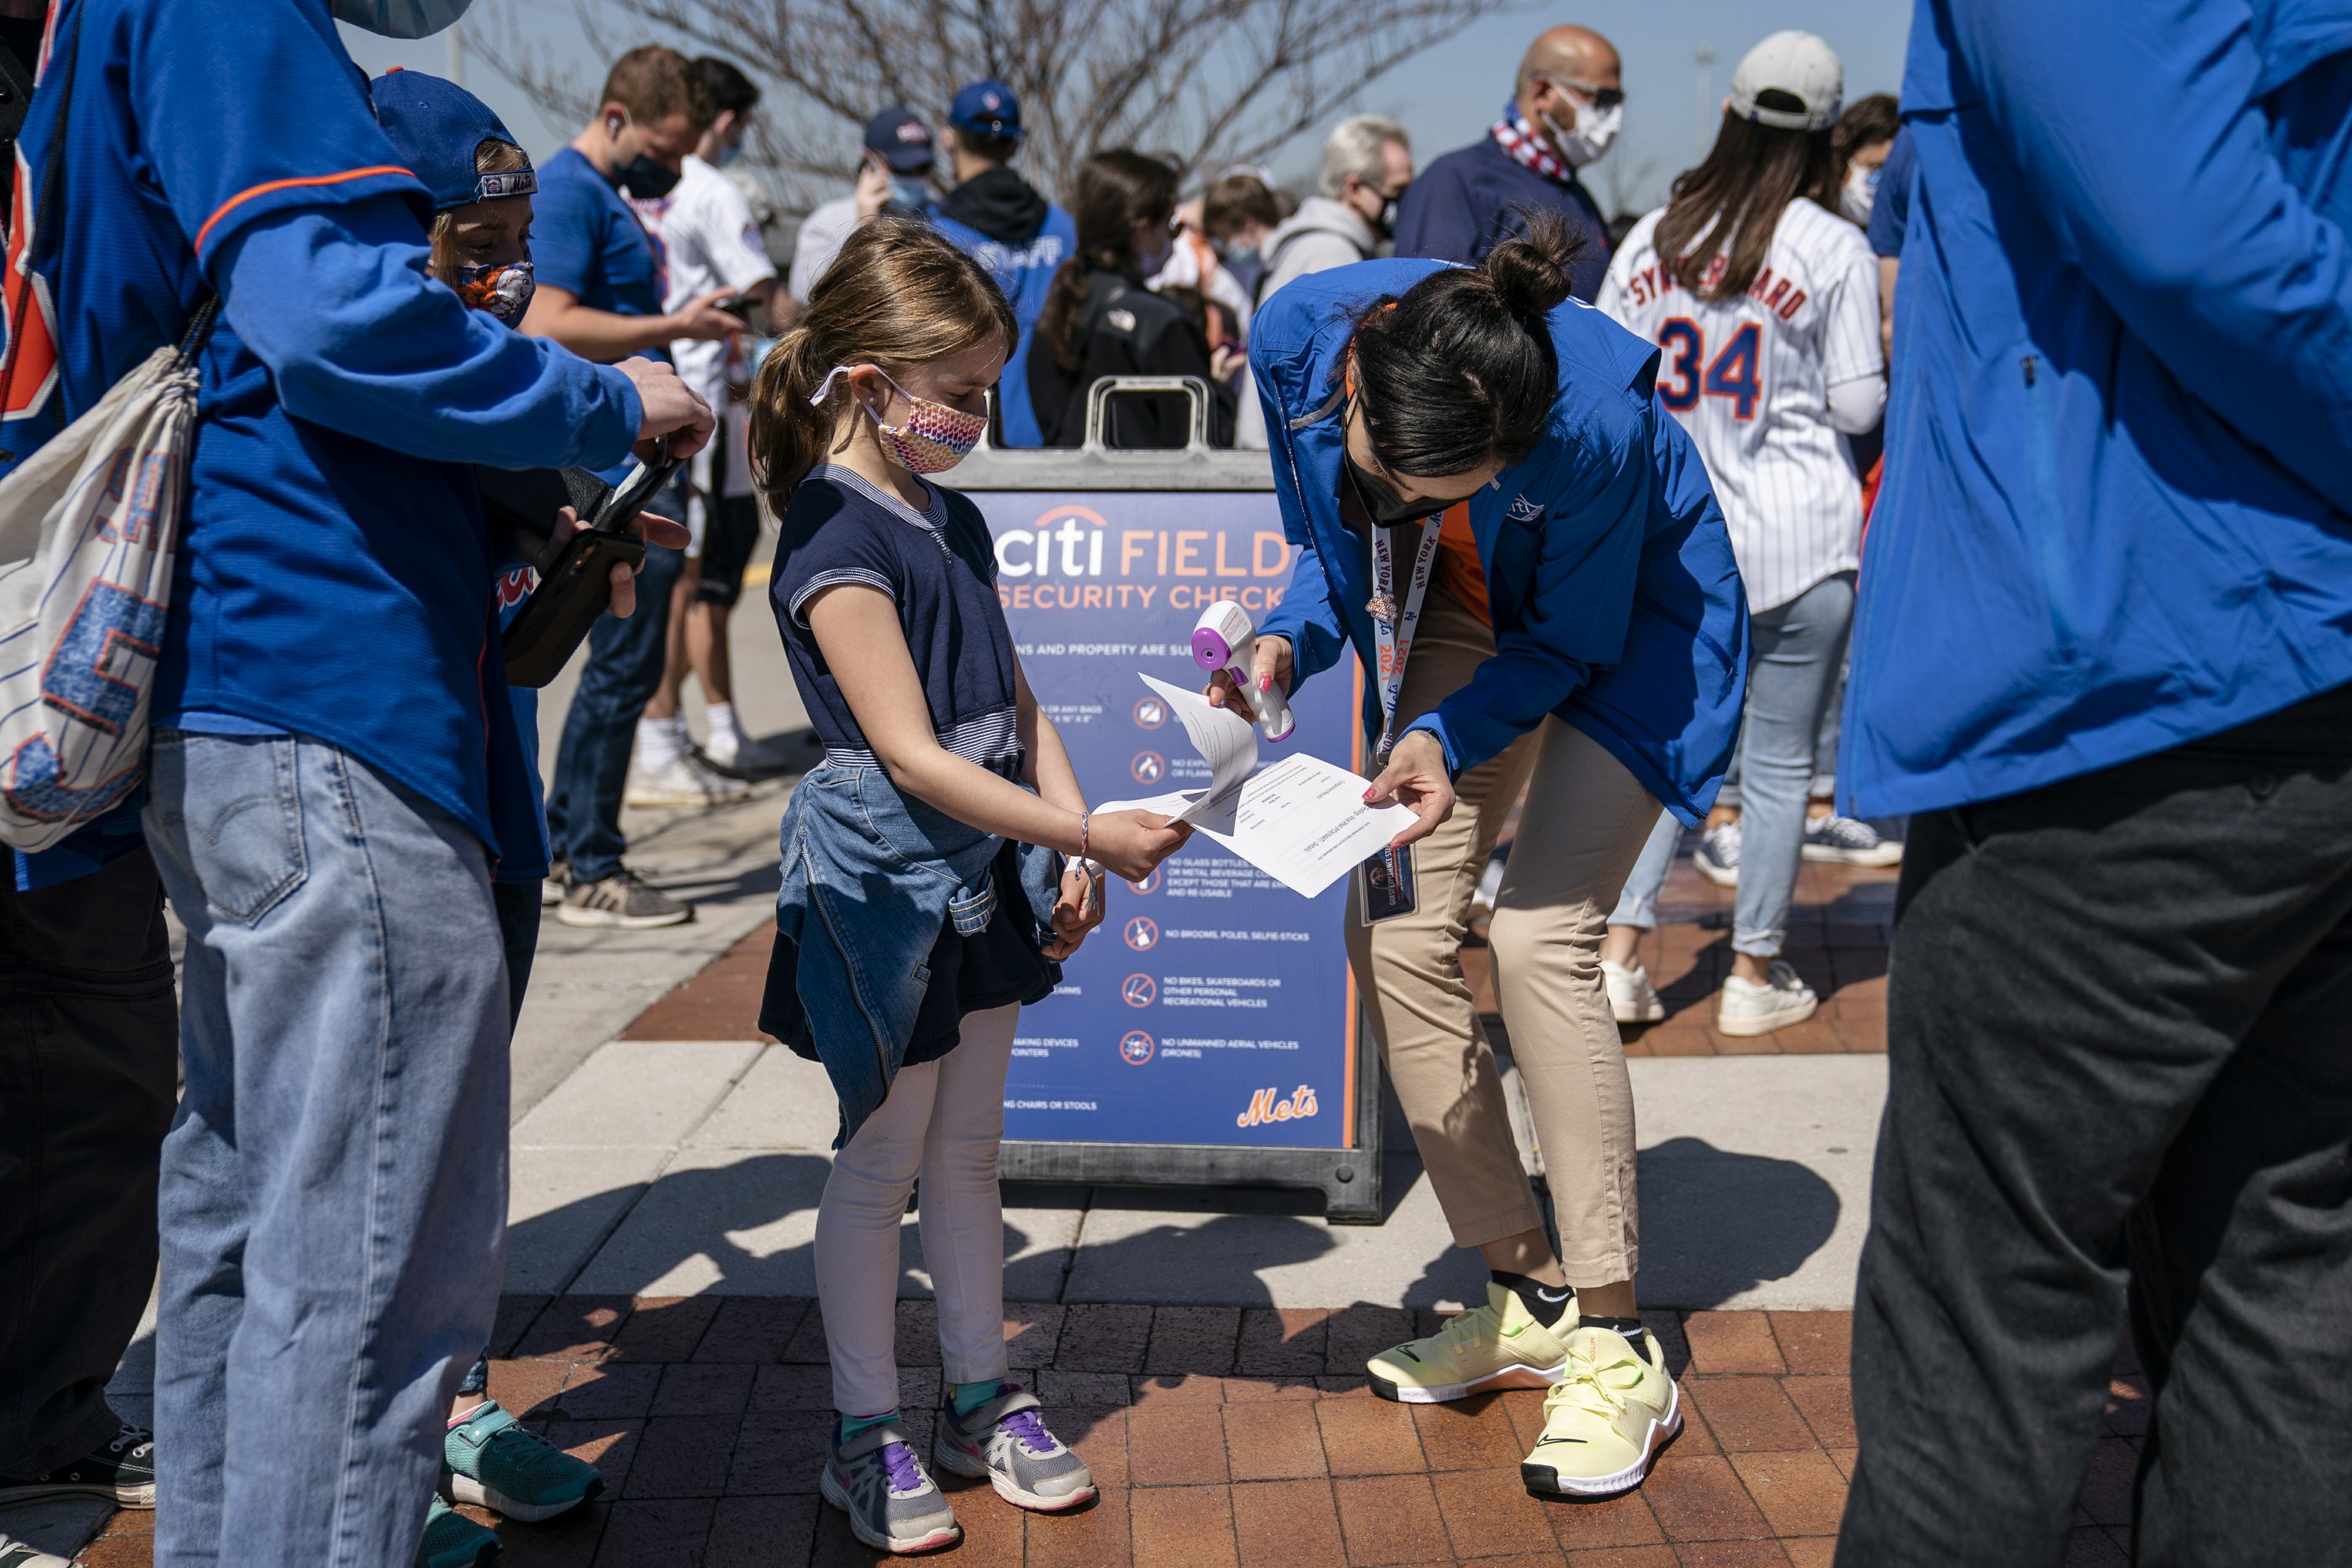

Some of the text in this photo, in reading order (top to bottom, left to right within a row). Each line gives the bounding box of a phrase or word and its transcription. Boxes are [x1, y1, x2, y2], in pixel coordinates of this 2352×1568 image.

[510, 175, 532, 193] Mets
[1656, 316, 1762, 421] 34
[1509, 501, 1530, 514] iti
[994, 517, 1291, 577] citi FIELD
[1374, 539, 1390, 563] NEW
[1415, 535, 1436, 590] NEW YORK
[1000, 584, 1286, 611] SECURITY CHECK
[1016, 644, 1192, 656] NS AND PROPERTY ARE SUB
[1380, 644, 1393, 681] 2021
[1393, 640, 1410, 675] 2021
[1387, 684, 1399, 714] Mets
[1080, 706, 1102, 714] BAGS
[1171, 759, 1185, 768] NO
[1168, 858, 1181, 866] NO
[1185, 858, 1210, 867] GLASS
[1167, 868, 1181, 877] OR
[1182, 869, 1208, 877] METAL
[1210, 869, 1254, 878] BEVERAGE
[1385, 857, 1396, 888] EXPERIENCE
[1167, 878, 1199, 887] EXCEPT
[1201, 879, 1230, 887] THOSE
[1231, 880, 1252, 888] THAT
[1253, 880, 1270, 889] ARE
[1167, 888, 1186, 897] AND
[1165, 930, 1179, 938] NO
[1180, 931, 1220, 940] BROOMS,
[1221, 931, 1250, 941] POLES,
[1163, 977, 1281, 988] NO BIKES, SKATEBOARDS OR
[1054, 986, 1081, 995] EARMS
[1163, 987, 1238, 996] OTHER PERSONAL
[1163, 997, 1268, 1008] RECREATIONAL VEHICLES
[1013, 1038, 1079, 1047] AKING DEVICES
[1161, 1038, 1299, 1050] NO UNMANNED AERIAL VEHICLES
[1161, 1049, 1202, 1058] (DRONES)
[1016, 1101, 1048, 1109] CHAIRS
[1049, 1101, 1062, 1109] OR
[1063, 1102, 1098, 1111] STOOLS
[1236, 1084, 1319, 1128] Mets
